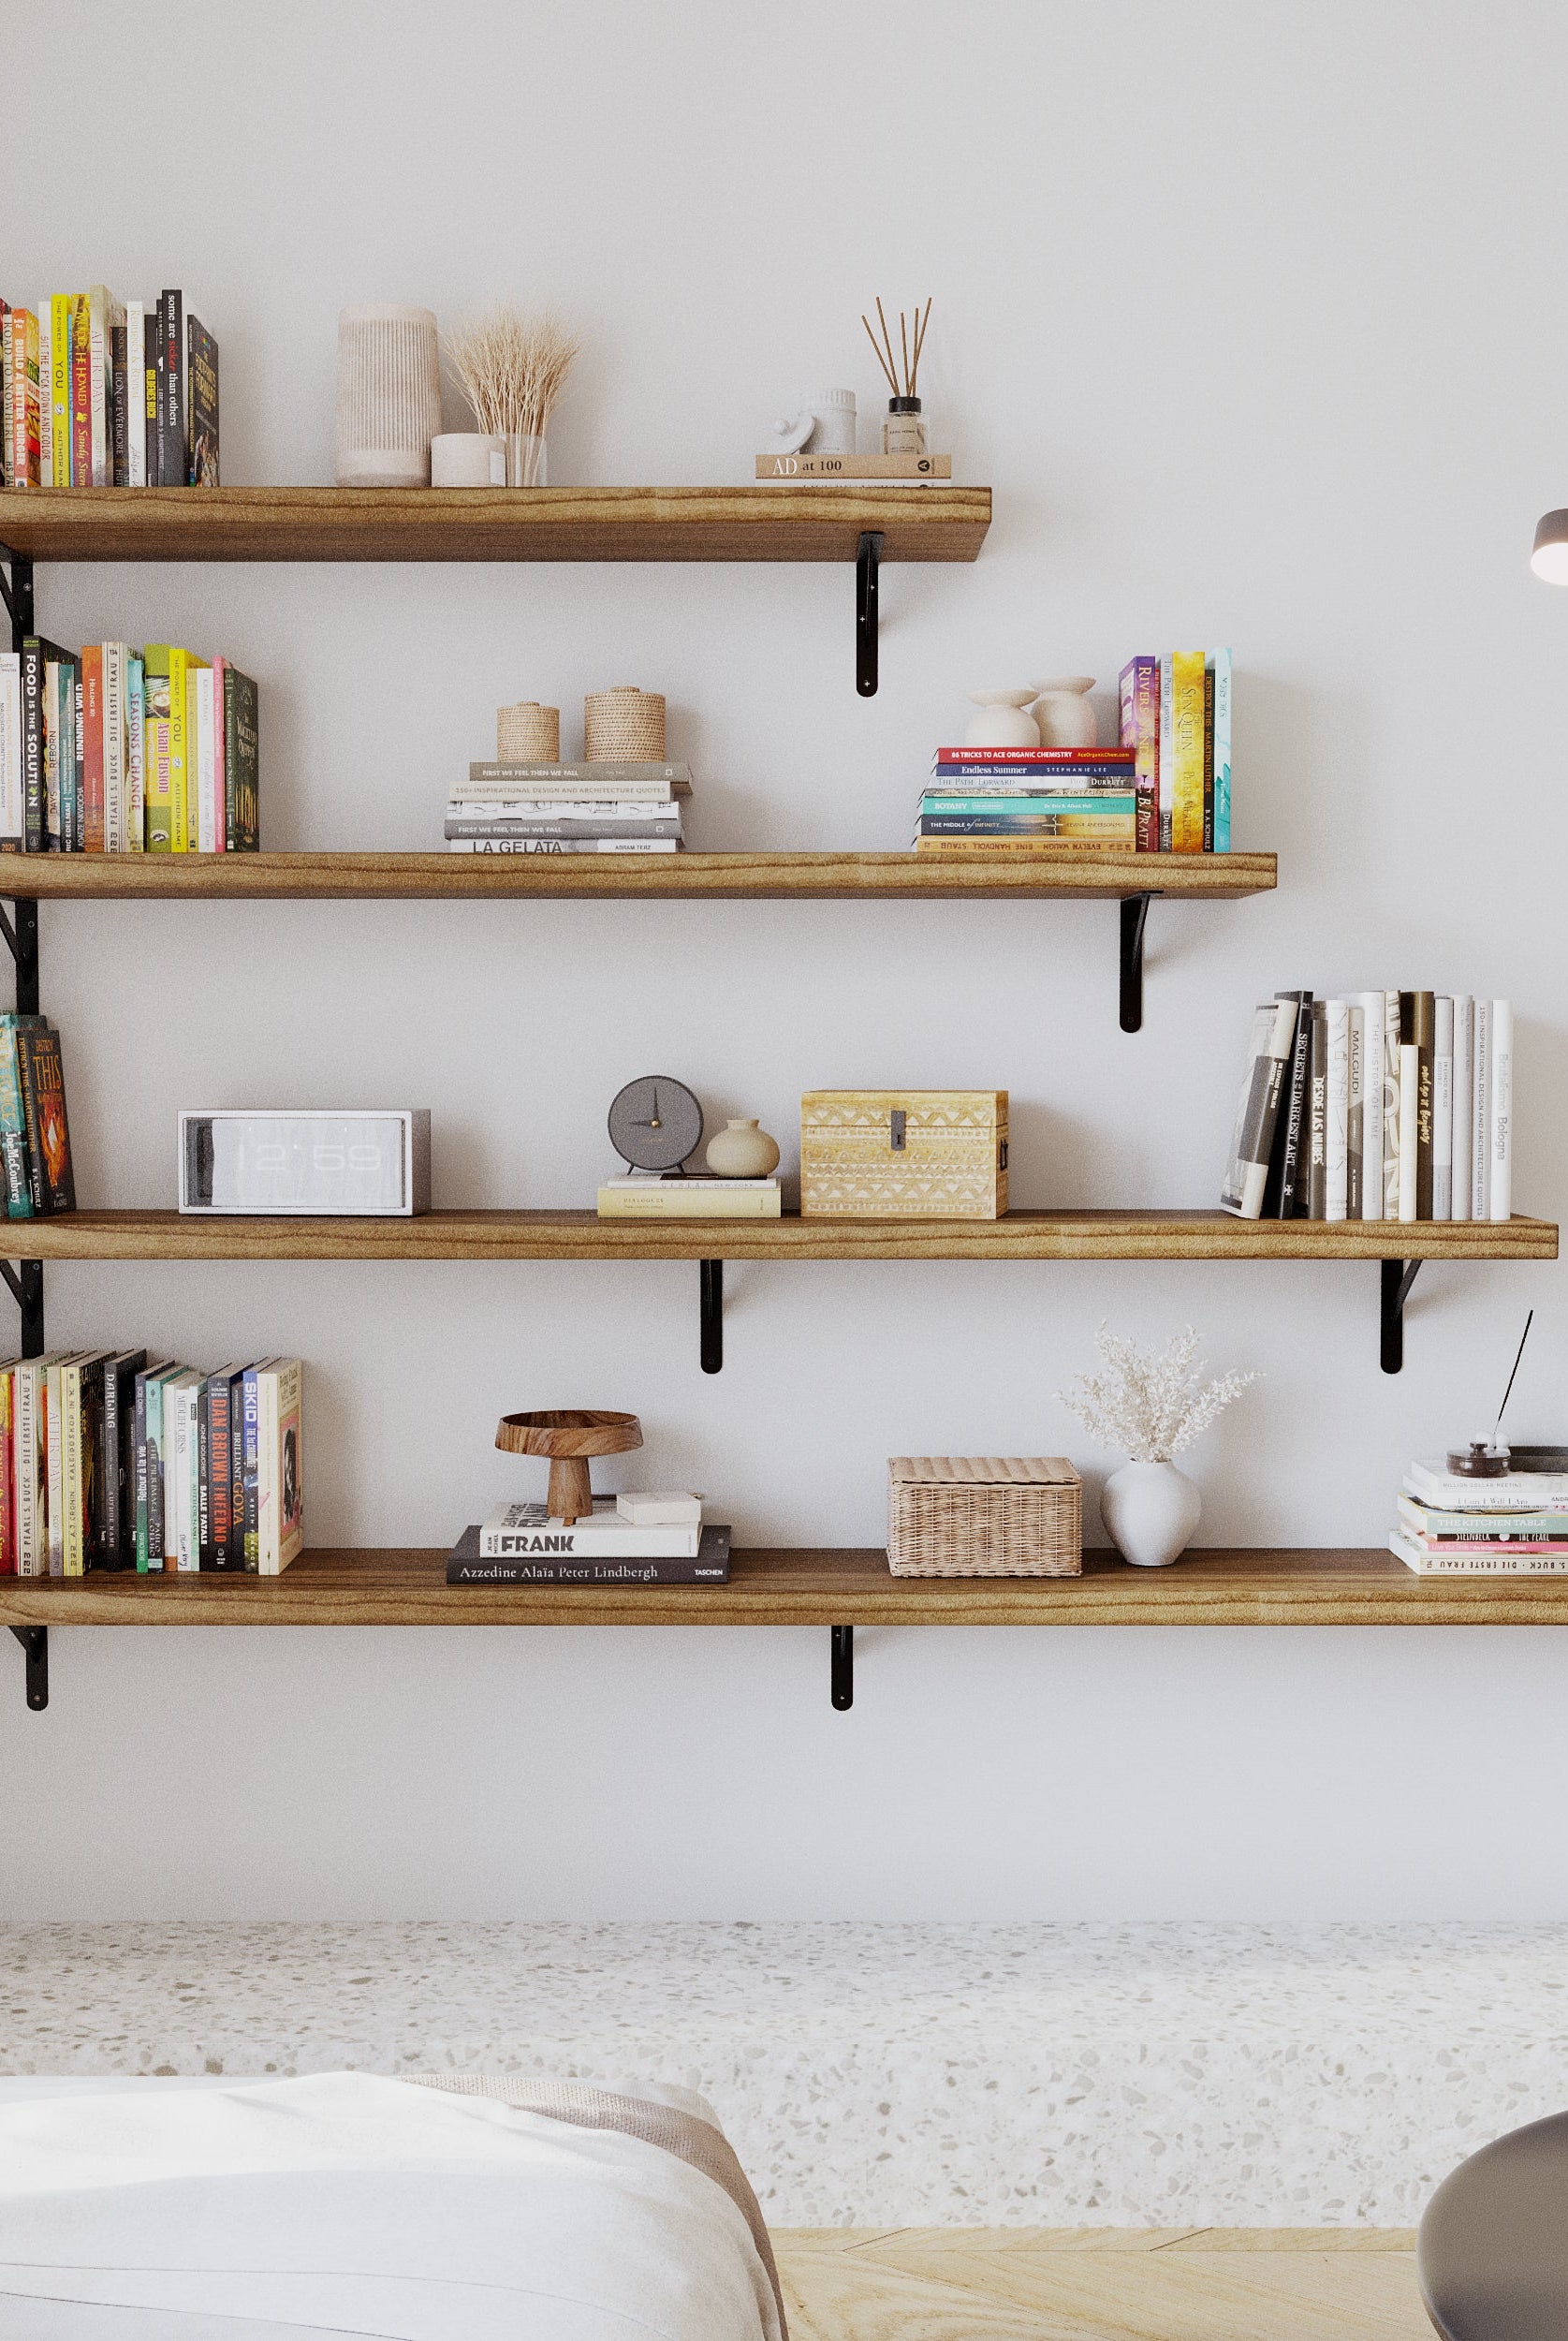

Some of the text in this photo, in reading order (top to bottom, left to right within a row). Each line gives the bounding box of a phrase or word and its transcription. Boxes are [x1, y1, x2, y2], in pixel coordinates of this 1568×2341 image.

[15, 339, 24, 369] BUILD
[169, 340, 179, 372] sicker
[4, 322, 13, 442] ROAD TO NOWHERE
[169, 373, 178, 393] than
[169, 397, 178, 426] others
[17, 423, 26, 464] BURGER
[773, 458, 843, 474] AD at 100
[1181, 688, 1196, 710] SUN
[75, 712, 83, 760] RUNNING
[173, 714, 182, 742] YOU
[130, 693, 142, 811] SEASONS CHANGE
[157, 723, 170, 794] Asian Fusion
[49, 730, 58, 815] DAYS REBORN
[474, 841, 562, 853] LA GELATA
[1370, 1024, 1380, 1041] THE
[19, 1038, 28, 1067] DESTROY
[24, 1092, 34, 1123] MARTIN
[33, 1054, 62, 1090] THIS
[1370, 1049, 1379, 1092] HISTORY
[1286, 1033, 1308, 1166] SECRETS DARKEST ART
[1370, 1097, 1378, 1109] OF
[1495, 1053, 1509, 1160] Brutalismo Bologna
[106, 1374, 115, 1428] DARLING
[212, 1399, 227, 1427] DAN
[137, 1446, 147, 1457] vie
[178, 1429, 186, 1453] CRISIS
[212, 1433, 228, 1482] BROWN
[50, 1459, 60, 1491] DAYS
[137, 1476, 147, 1501] Retour
[213, 1487, 227, 1542] INFERNO
[232, 1482, 243, 1524] GOYA
[502, 1536, 575, 1553] FRANK
[461, 1566, 658, 1581] Azzedine Alaïa Peter Lindbergh
